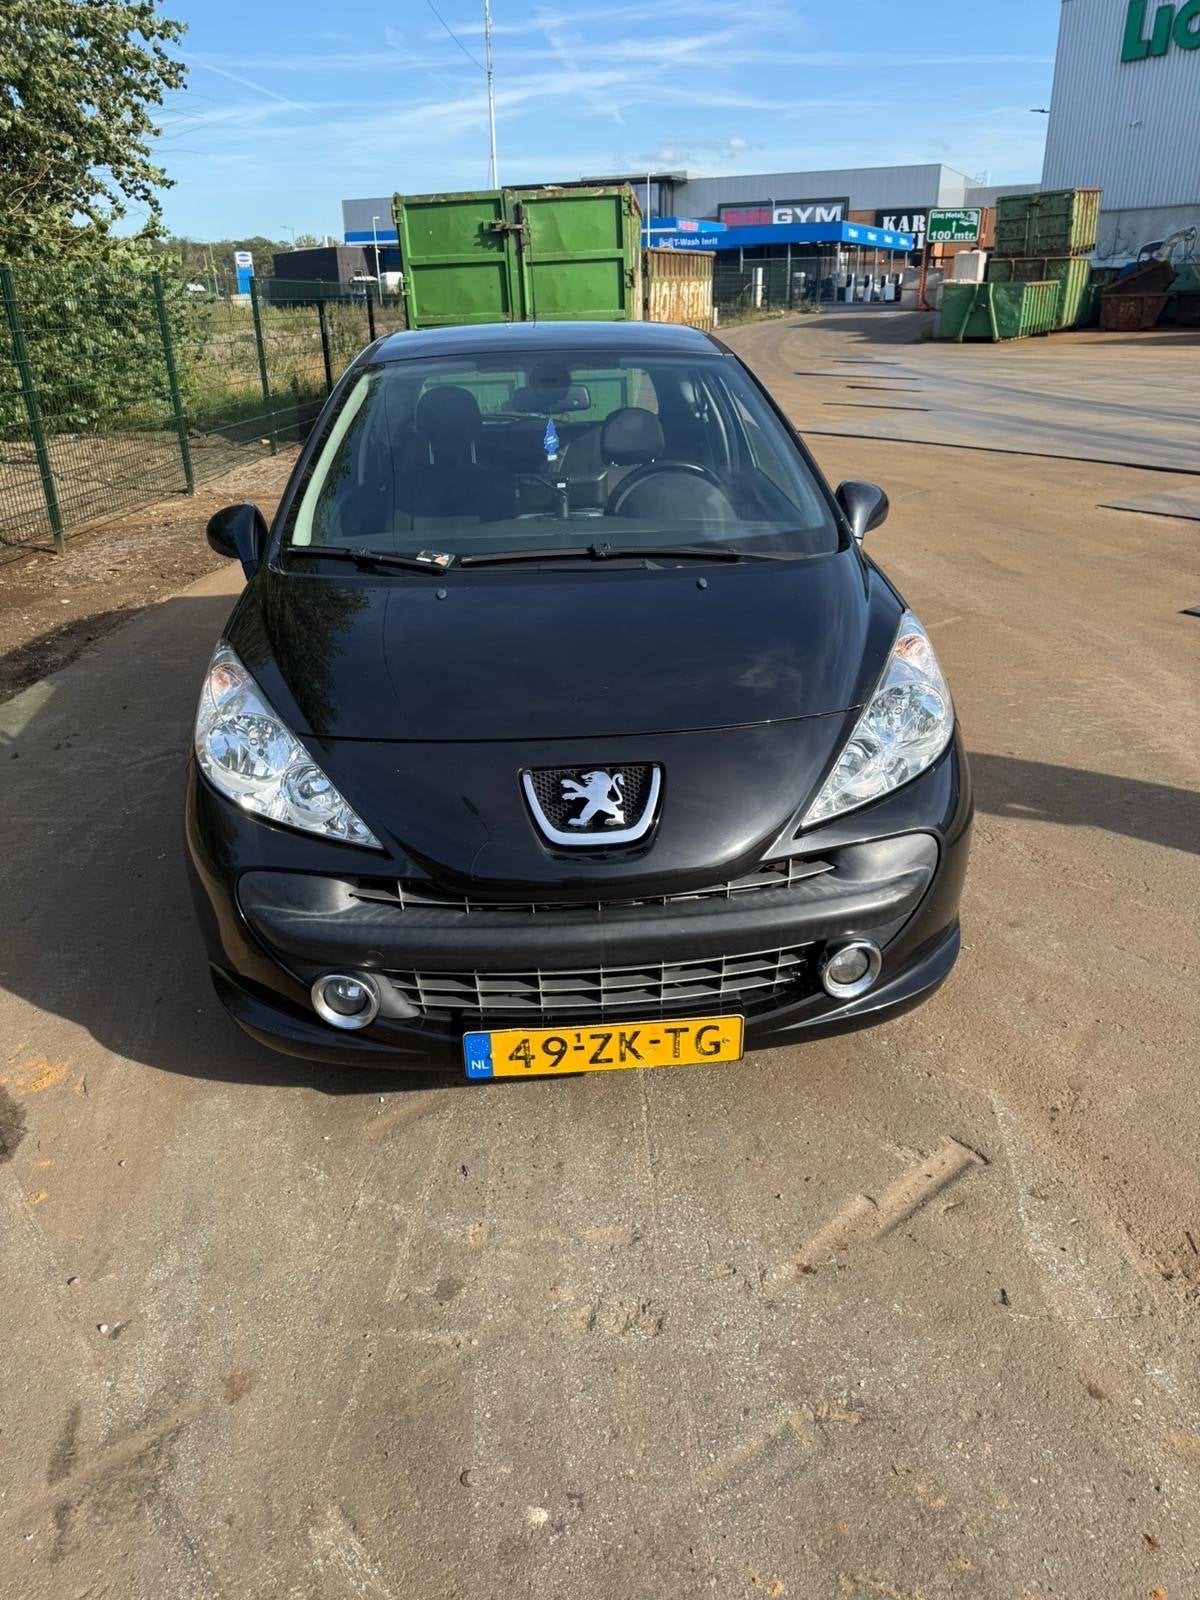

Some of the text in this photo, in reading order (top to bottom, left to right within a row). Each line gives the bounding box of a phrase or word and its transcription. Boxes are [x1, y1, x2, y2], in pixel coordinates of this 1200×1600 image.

[772, 205, 842, 224] GYM
[931, 211, 945, 219] Lion
[883, 215, 926, 232] KAR
[931, 230, 976, 240] 100 mtr.
[674, 237, 700, 246] T-Wash
[471, 1059, 489, 1070] NL
